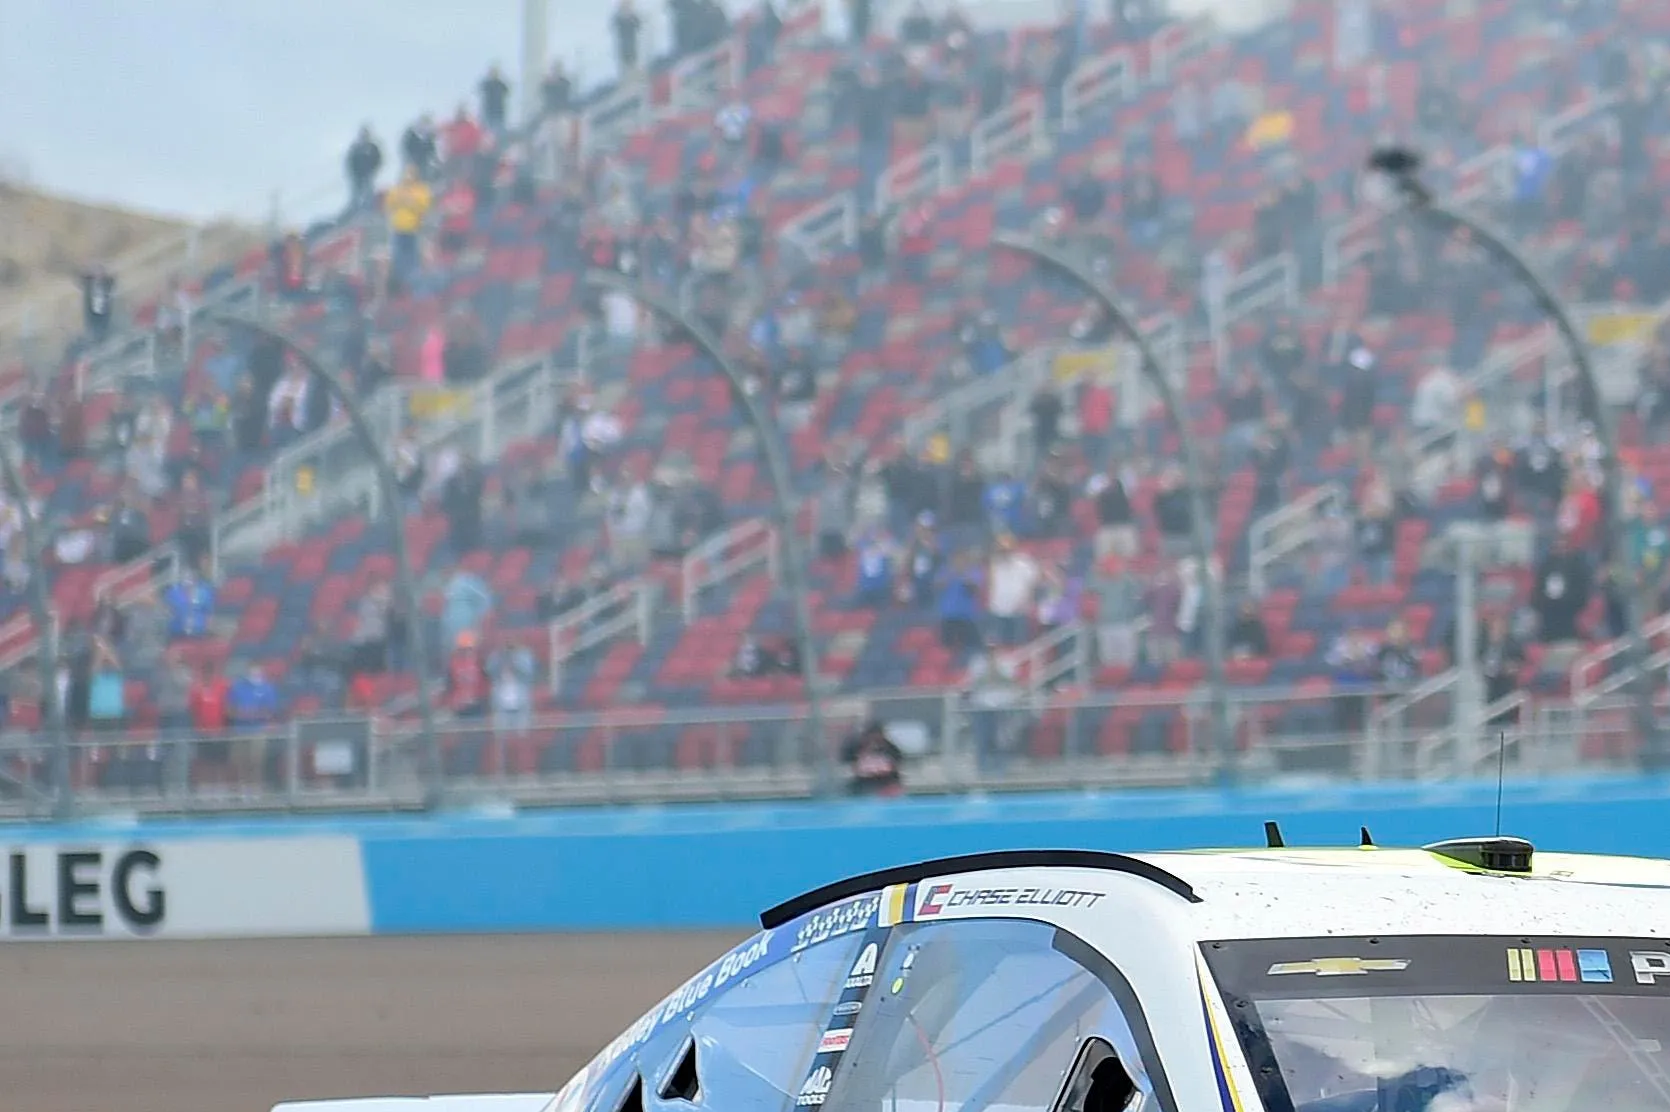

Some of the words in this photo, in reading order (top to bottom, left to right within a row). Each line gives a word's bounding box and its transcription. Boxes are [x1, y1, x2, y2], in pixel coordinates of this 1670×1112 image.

[0, 848, 168, 934] LEG
[947, 888, 1017, 907] CHASE
[1016, 888, 1107, 908] ELLIOTT
[662, 974, 713, 1024] Blue
[714, 931, 775, 988] Book
